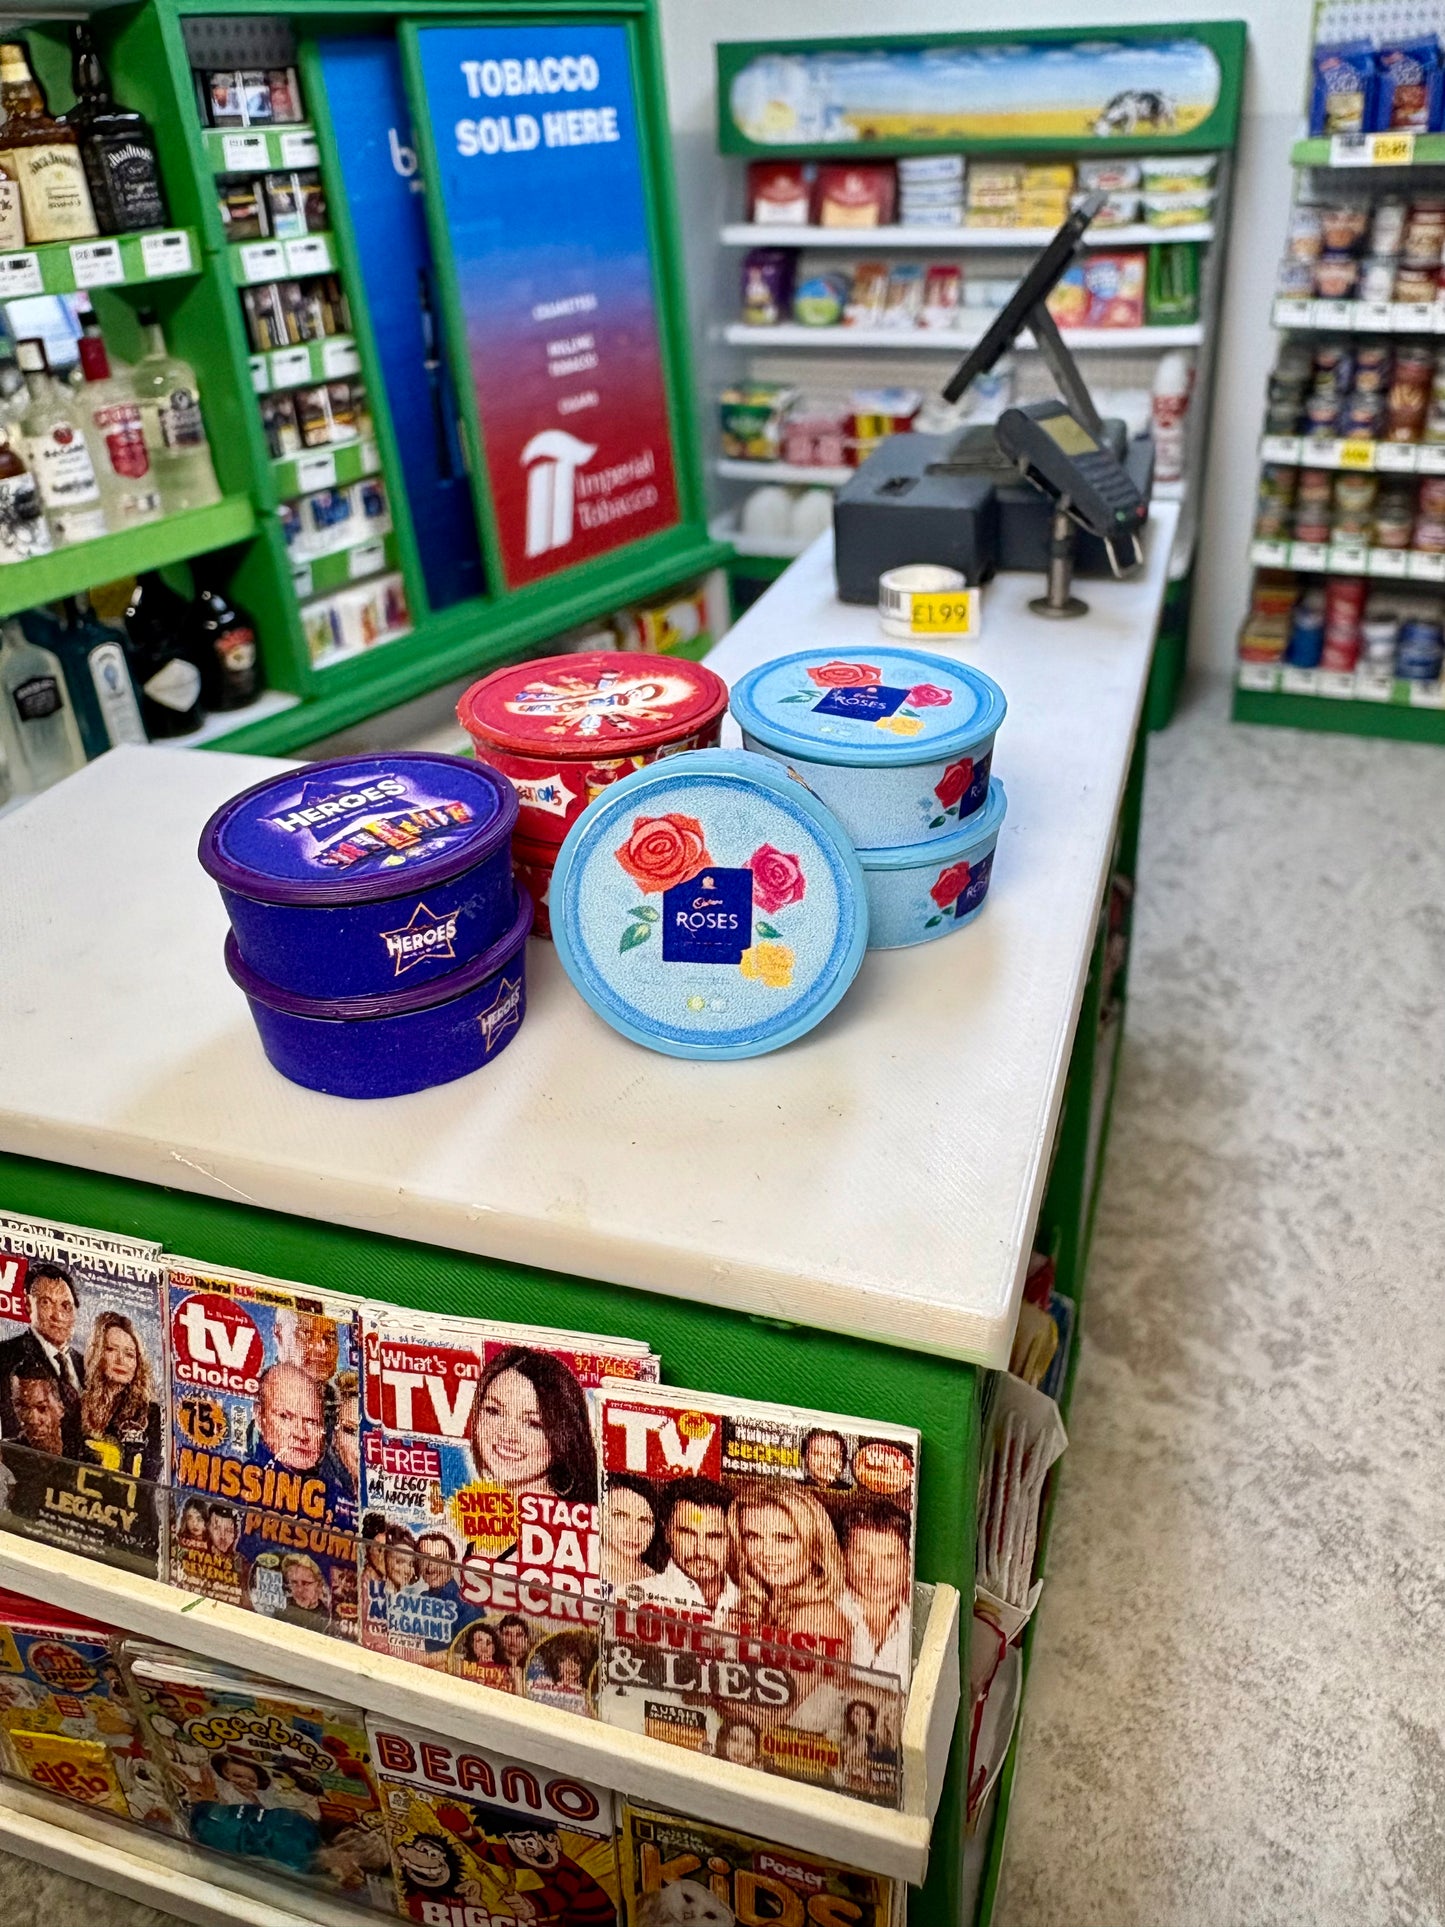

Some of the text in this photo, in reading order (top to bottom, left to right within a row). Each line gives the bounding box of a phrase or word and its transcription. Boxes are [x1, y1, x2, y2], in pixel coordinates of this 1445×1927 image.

[461, 55, 599, 98] TOBACCO
[455, 107, 620, 157] SOLD HERE
[834, 696, 887, 711] ROSES
[272, 779, 407, 833] HEROES
[386, 919, 458, 957] HEROES
[676, 911, 739, 932] ROSES
[11, 1237, 66, 1264] BOWL
[179, 1302, 256, 1370] tv
[177, 1362, 259, 1393] choice
[380, 1348, 447, 1374] What's
[453, 1362, 480, 1380] on
[382, 1370, 477, 1438] TV
[383, 1446, 440, 1475] FREE
[606, 1408, 717, 1478] TV
[178, 1448, 334, 1524] MISSING,
[385, 1490, 427, 1507] MOVIE
[394, 1475, 428, 1492] LEGO
[45, 1487, 139, 1533] LEGACY
[457, 1490, 515, 1514] SHE'S
[463, 1516, 518, 1538] BACK
[607, 1645, 791, 1706] & LIES
[374, 1731, 600, 1822] BEANO
[760, 1855, 826, 1889] Poster
